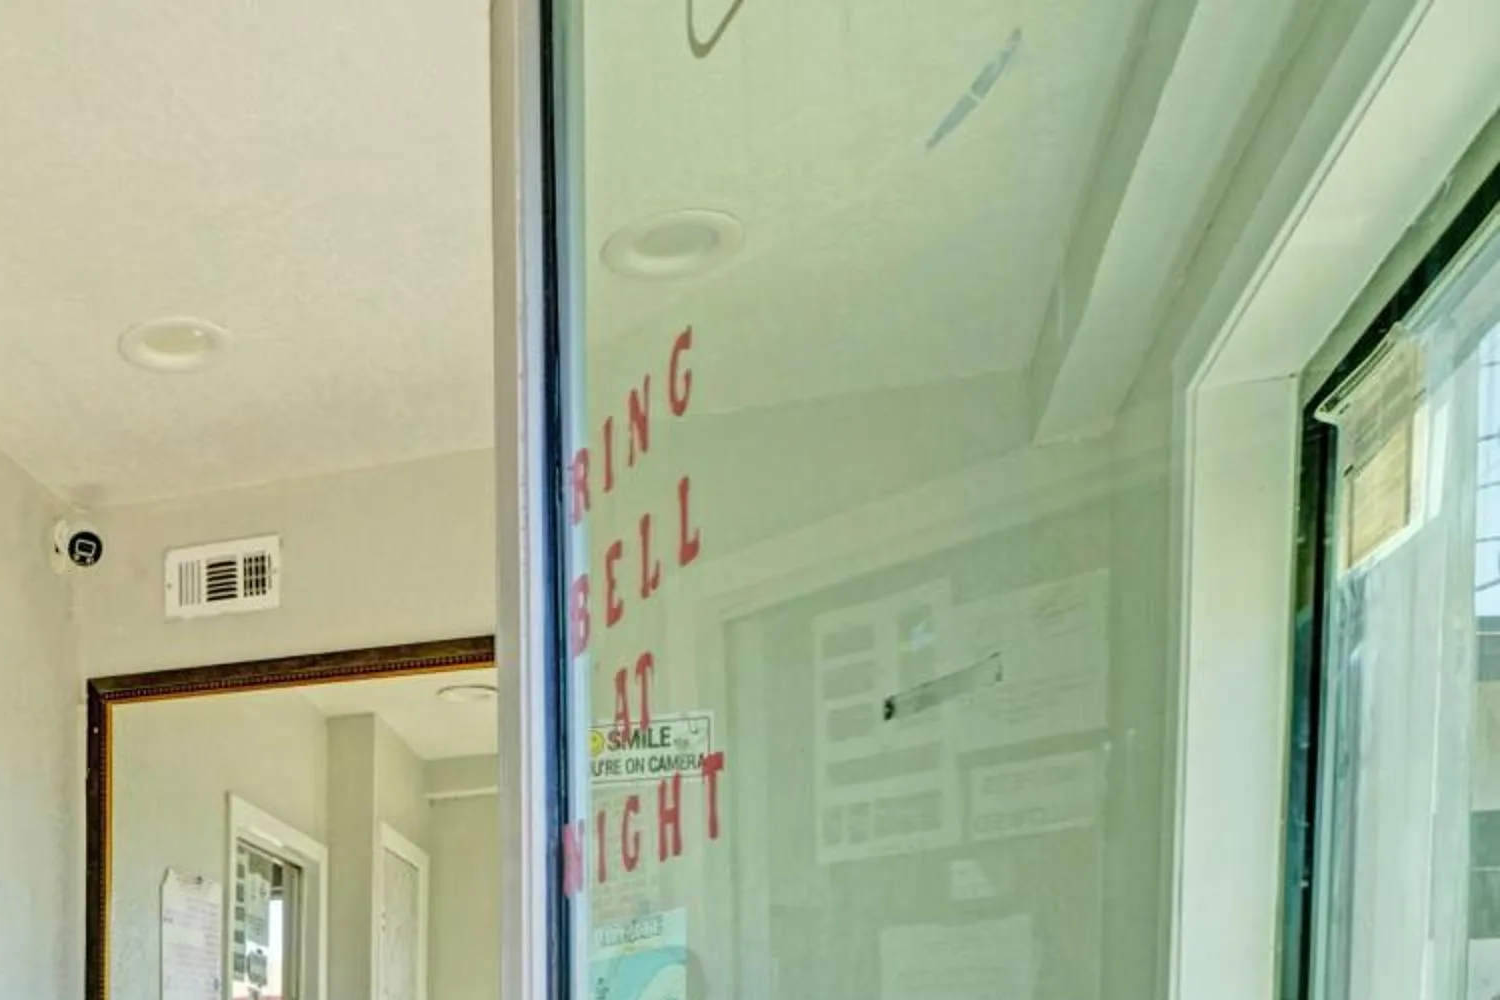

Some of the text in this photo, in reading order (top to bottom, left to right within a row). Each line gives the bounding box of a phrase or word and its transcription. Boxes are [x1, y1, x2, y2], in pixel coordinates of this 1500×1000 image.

[569, 325, 693, 526] RING
[569, 477, 700, 658] BELL
[607, 726, 672, 751] SMILE
[615, 652, 654, 740] AT
[625, 756, 645, 774] ON
[563, 752, 724, 897] NIGHT
